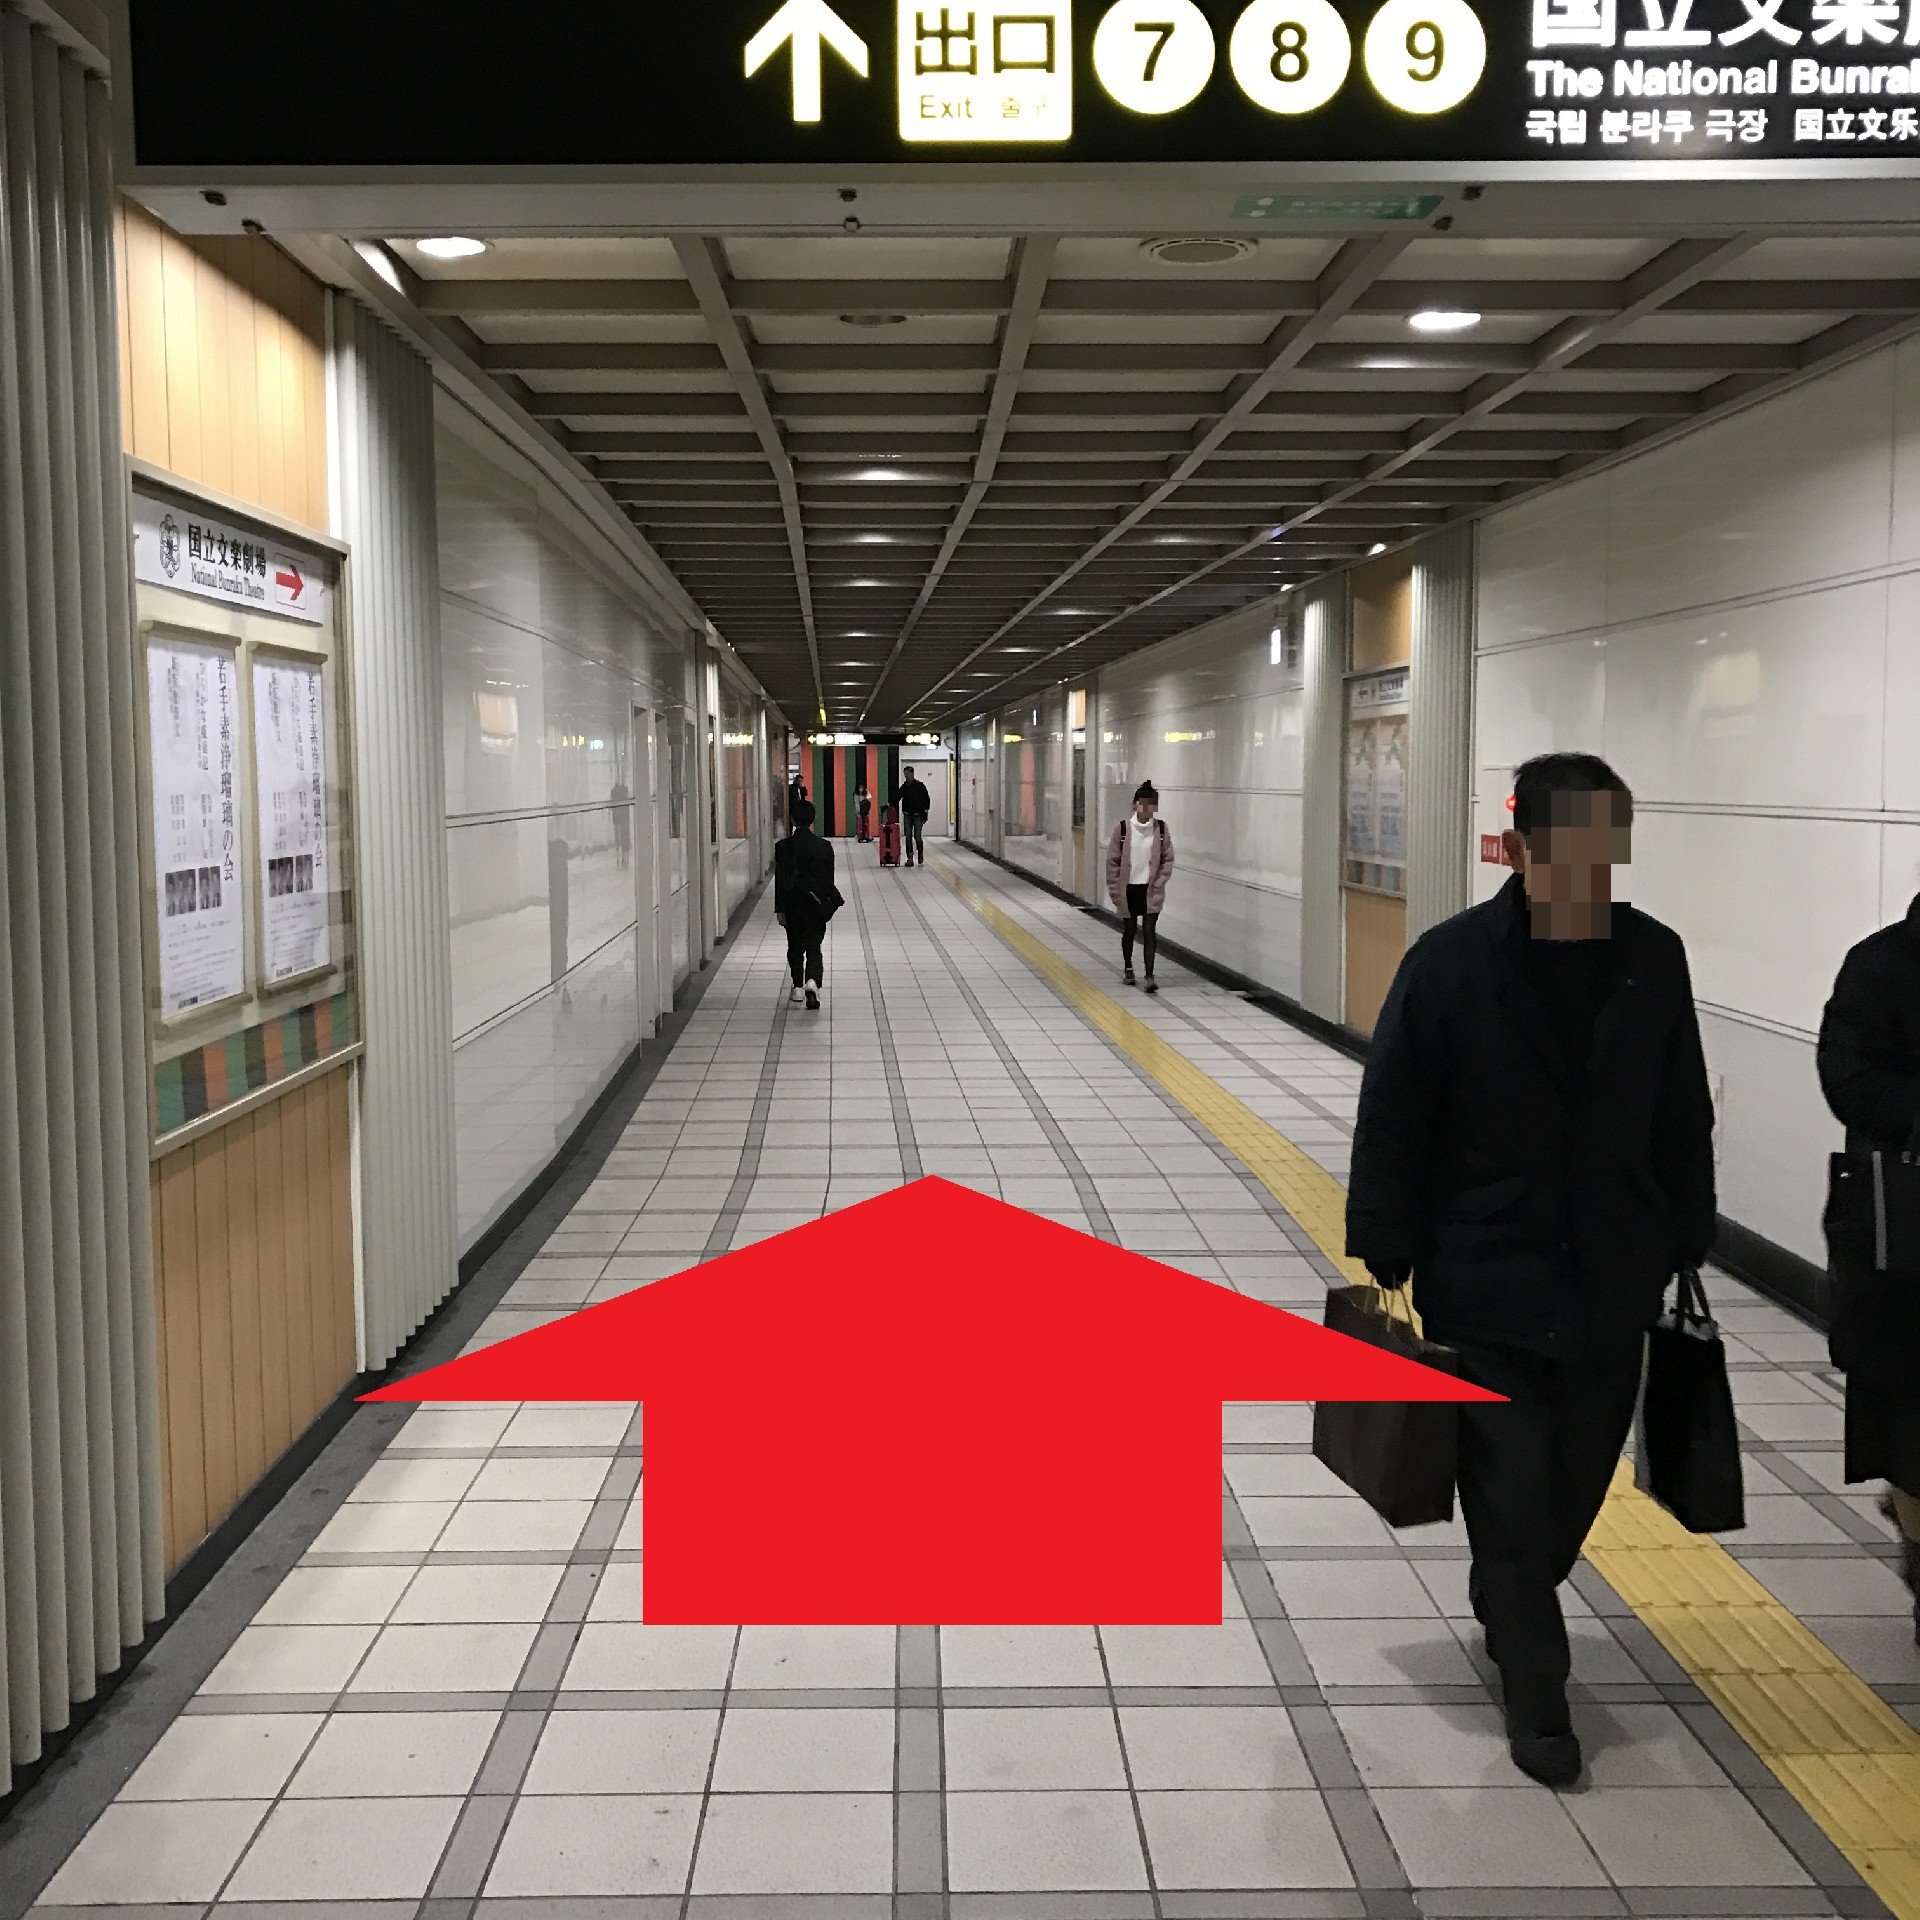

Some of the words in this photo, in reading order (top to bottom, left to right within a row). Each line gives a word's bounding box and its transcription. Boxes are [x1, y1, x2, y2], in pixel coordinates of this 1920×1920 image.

[914, 7, 1056, 76] 出口
[1531, 0, 1919, 48] 国立文楽
[1134, 21, 1176, 82] 7
[1270, 21, 1310, 83] 8
[1405, 20, 1445, 83] 9
[1526, 59, 1603, 97] The
[1613, 59, 1778, 97] National
[920, 94, 974, 119] Exit
[1795, 107, 1919, 142] 国立文乐
[1525, 109, 1587, 144] 국립
[1600, 109, 1695, 144] 분라쿠
[1705, 108, 1769, 143] 극장
[188, 521, 266, 578] 国立文楽劇場
[191, 562, 217, 588] National
